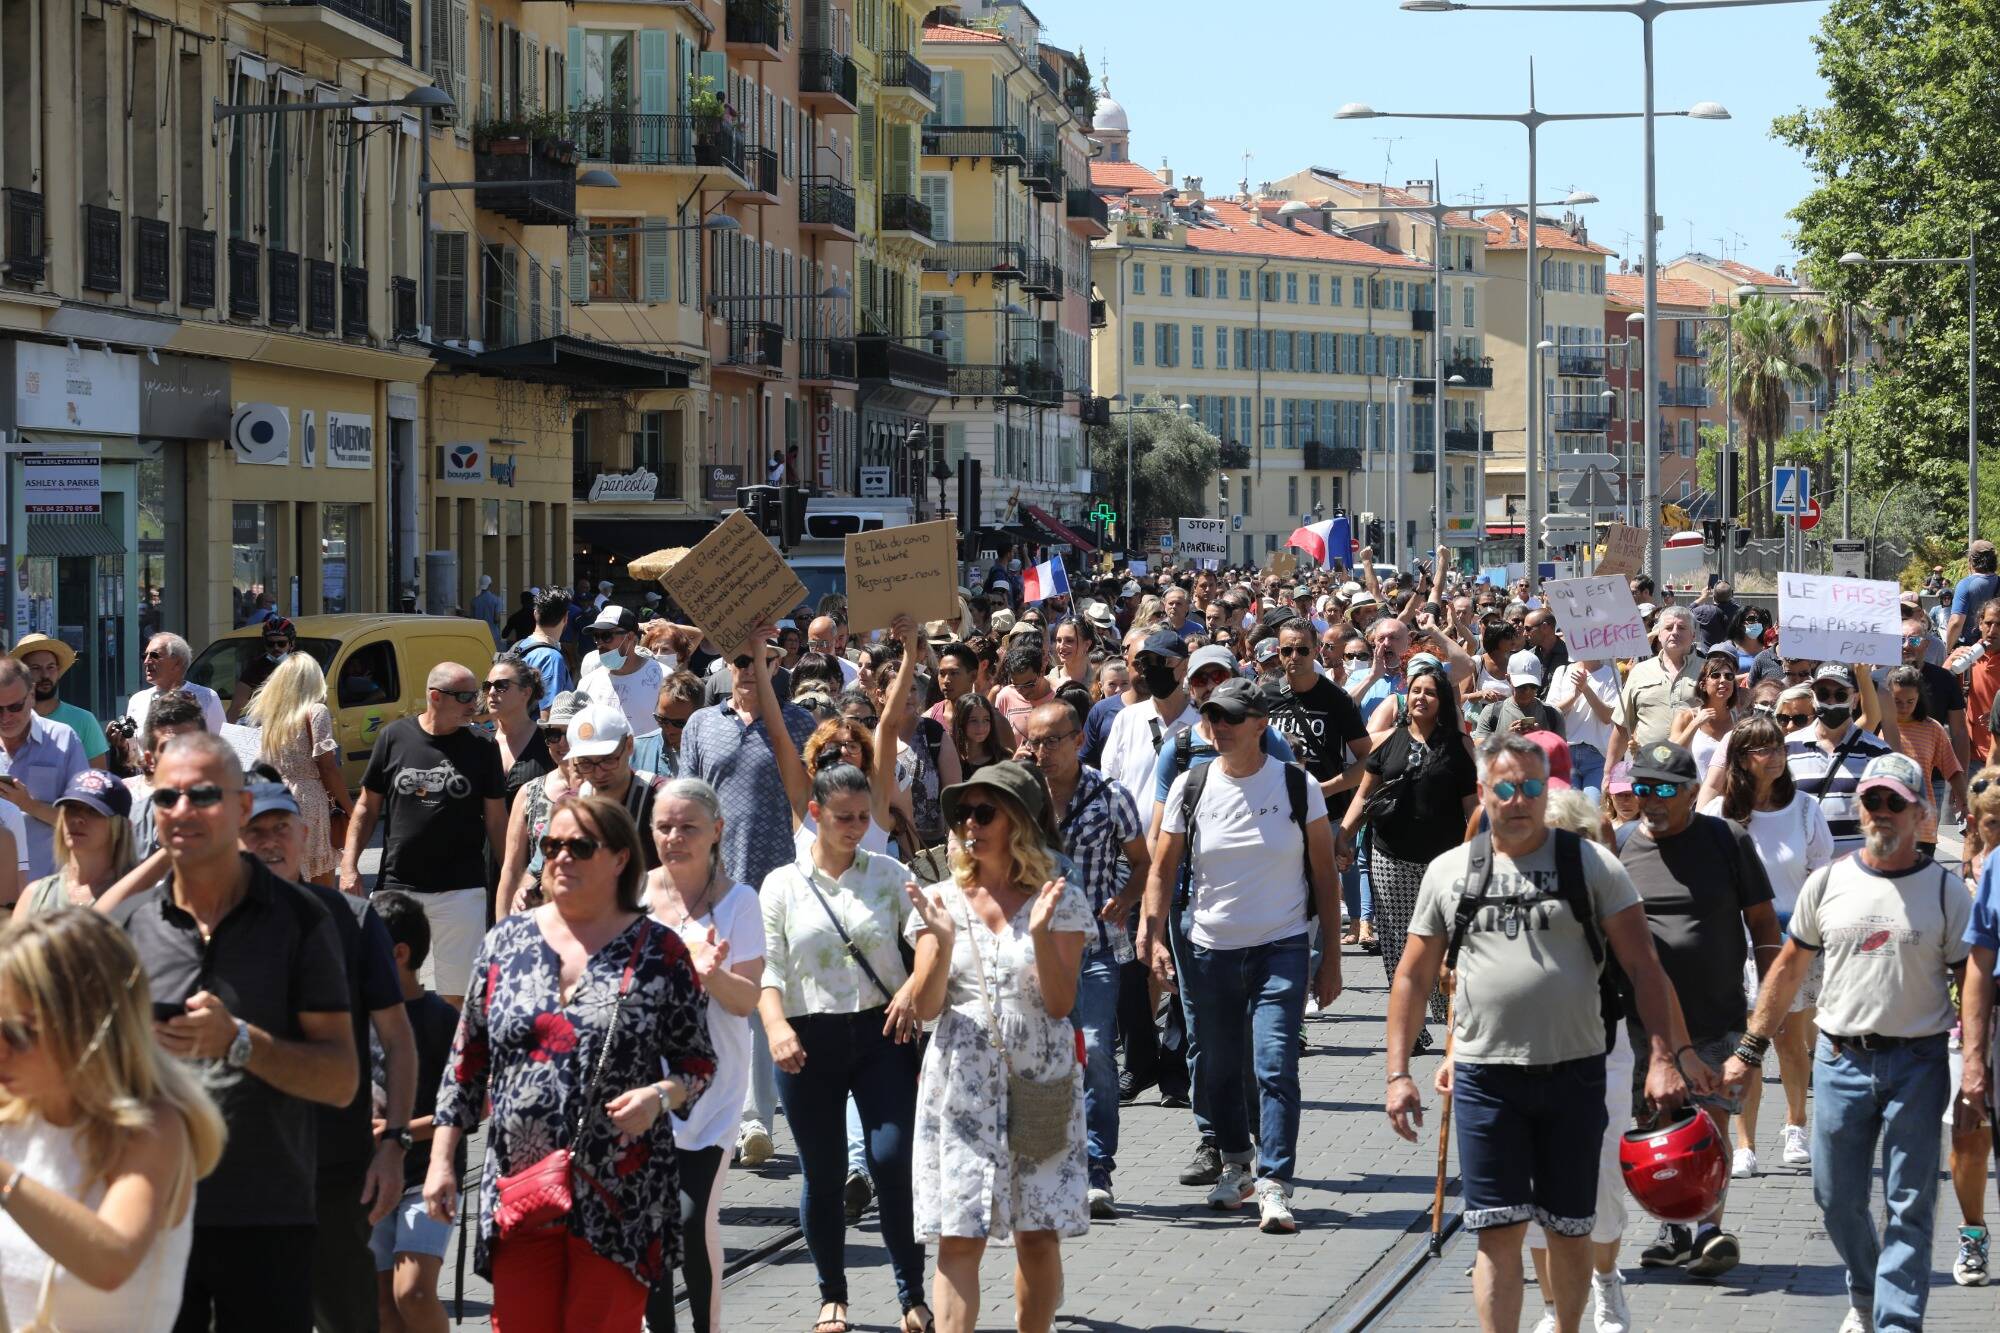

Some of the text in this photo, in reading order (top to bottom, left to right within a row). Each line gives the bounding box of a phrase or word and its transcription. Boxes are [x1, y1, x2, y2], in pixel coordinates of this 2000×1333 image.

[817, 396, 832, 488] HOTEL
[25, 479, 100, 487] ASHLEY & PARKER
[447, 470, 481, 480] bouygues
[1187, 520, 1216, 533] STOP
[665, 566, 698, 592] FRANCE
[1585, 581, 1616, 598] EST
[1787, 580, 1892, 608] LE PASS
[1569, 605, 1595, 619] LA
[1826, 616, 1883, 634] PASSE
[1839, 640, 1877, 657] PAS
[1198, 804, 1279, 820] FRIENDS
